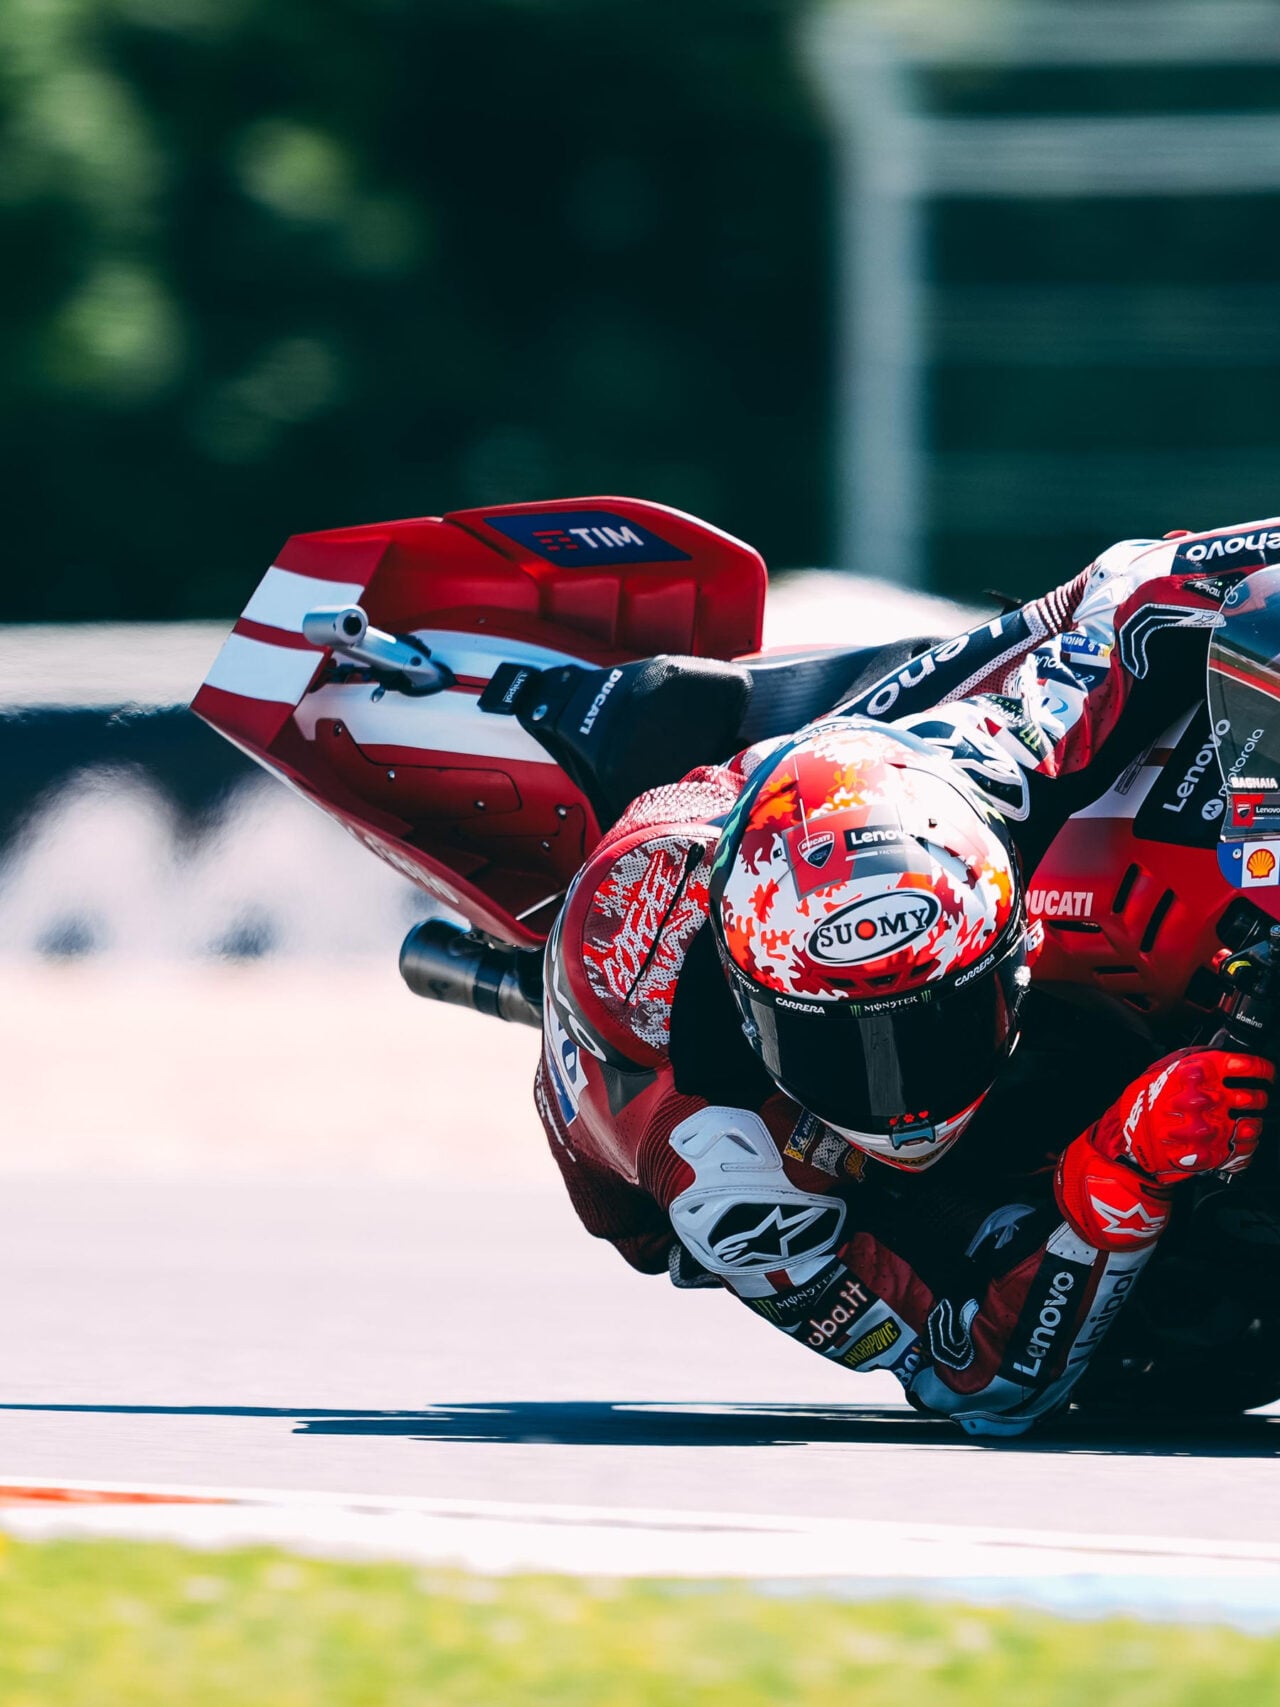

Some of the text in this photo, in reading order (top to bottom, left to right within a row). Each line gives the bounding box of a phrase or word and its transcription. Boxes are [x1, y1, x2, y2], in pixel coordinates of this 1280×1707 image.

[569, 526, 645, 549] TIM
[867, 617, 1004, 706] Leno
[579, 668, 624, 735] DUCATI
[1162, 719, 1232, 813] Lenovo
[1255, 805, 1280, 814] Lenovo
[817, 907, 928, 948] SUOMY
[954, 953, 996, 987] CARRERA
[775, 996, 826, 1014] CARRERA
[1236, 1011, 1263, 1029] domino
[807, 1280, 868, 1347] uba.it
[1012, 1271, 1075, 1377] Lenovo
